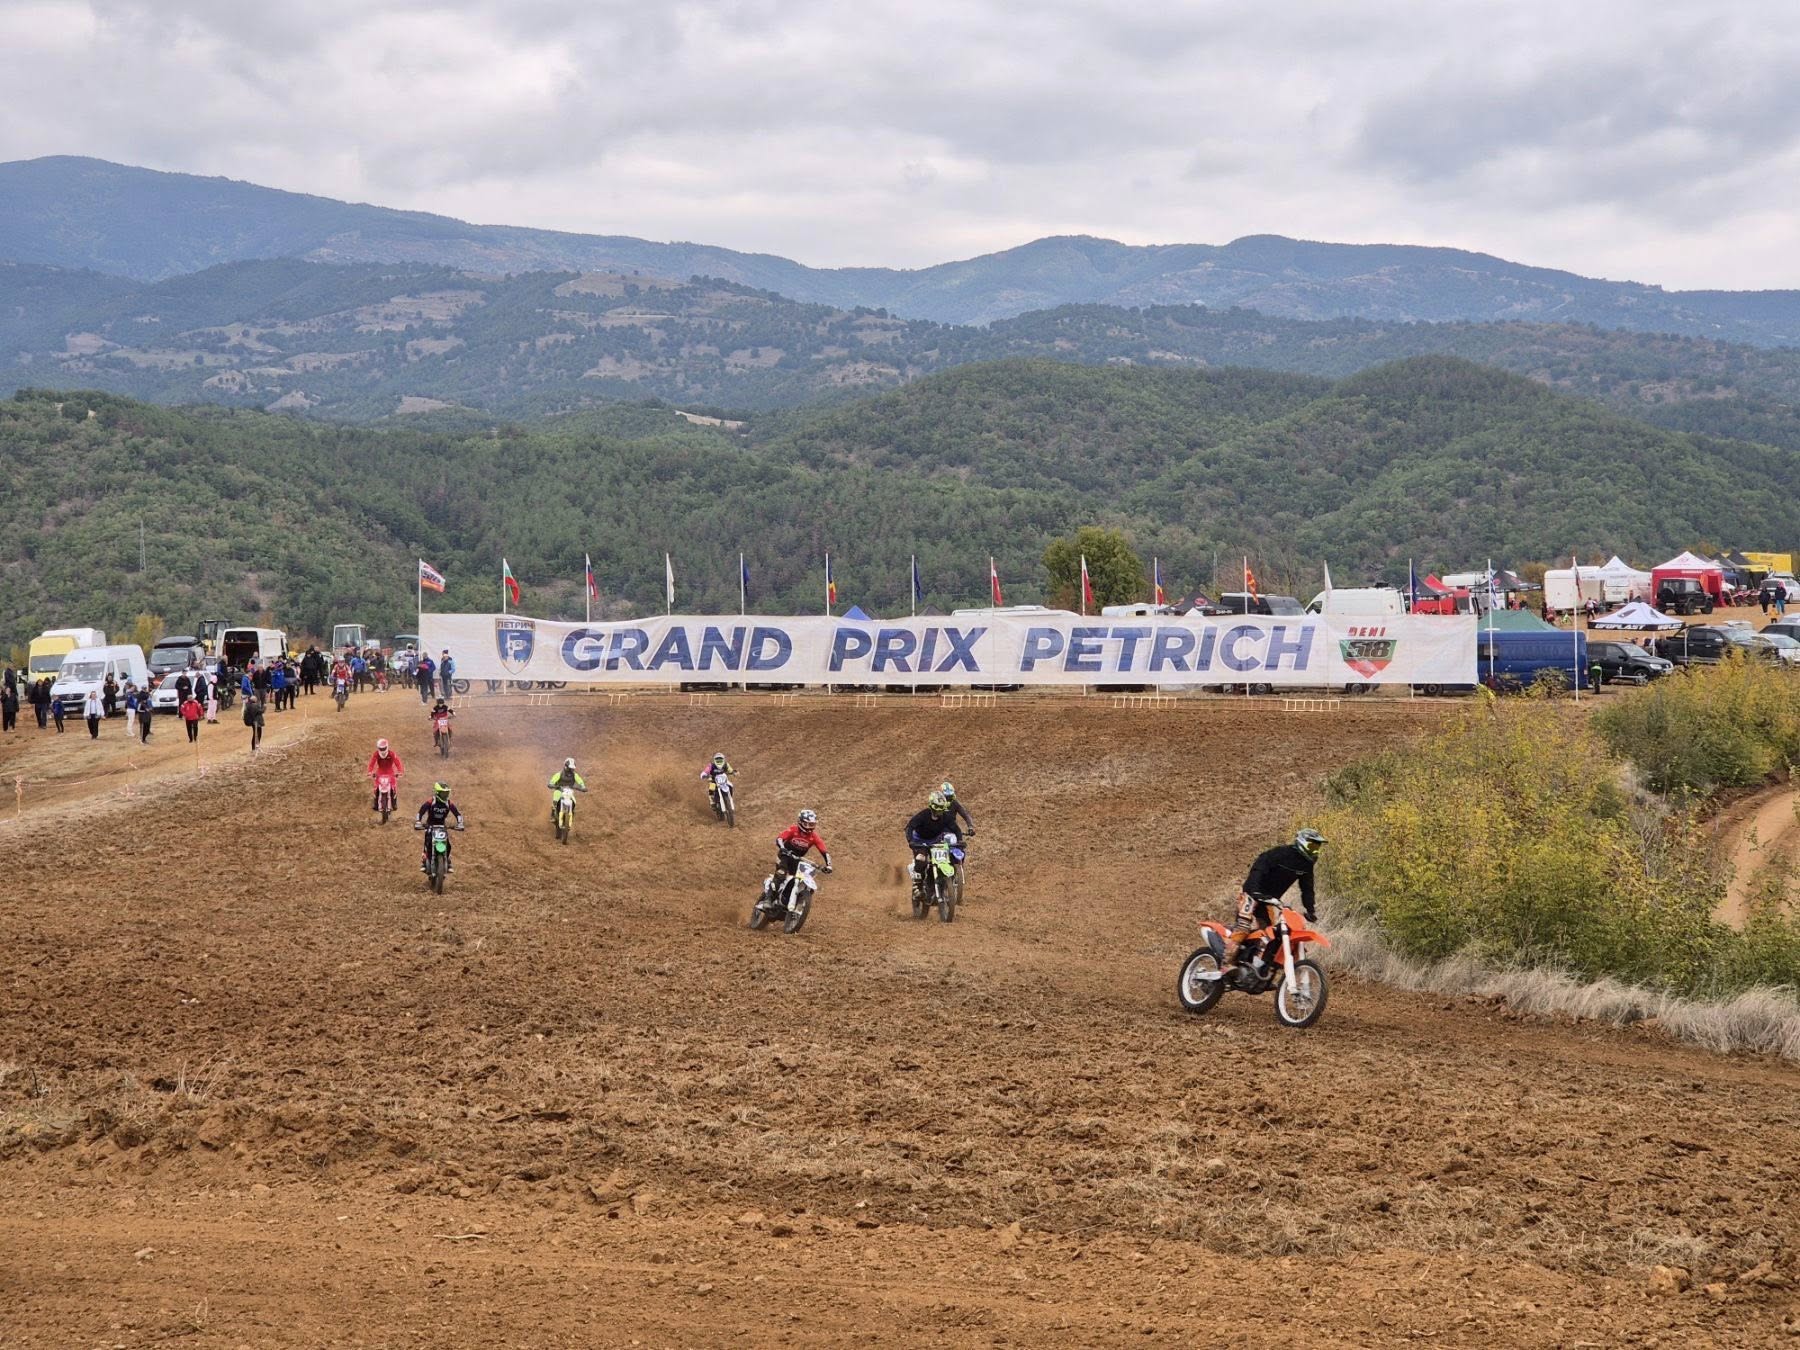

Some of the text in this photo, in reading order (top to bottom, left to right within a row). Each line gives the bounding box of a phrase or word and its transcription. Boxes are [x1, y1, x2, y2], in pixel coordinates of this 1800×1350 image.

[497, 621, 535, 630] ПЕТРИЧ
[1348, 627, 1386, 637] DENI
[561, 625, 1316, 672] GRAND PRIX PETRICH
[1346, 641, 1391, 657] 518
